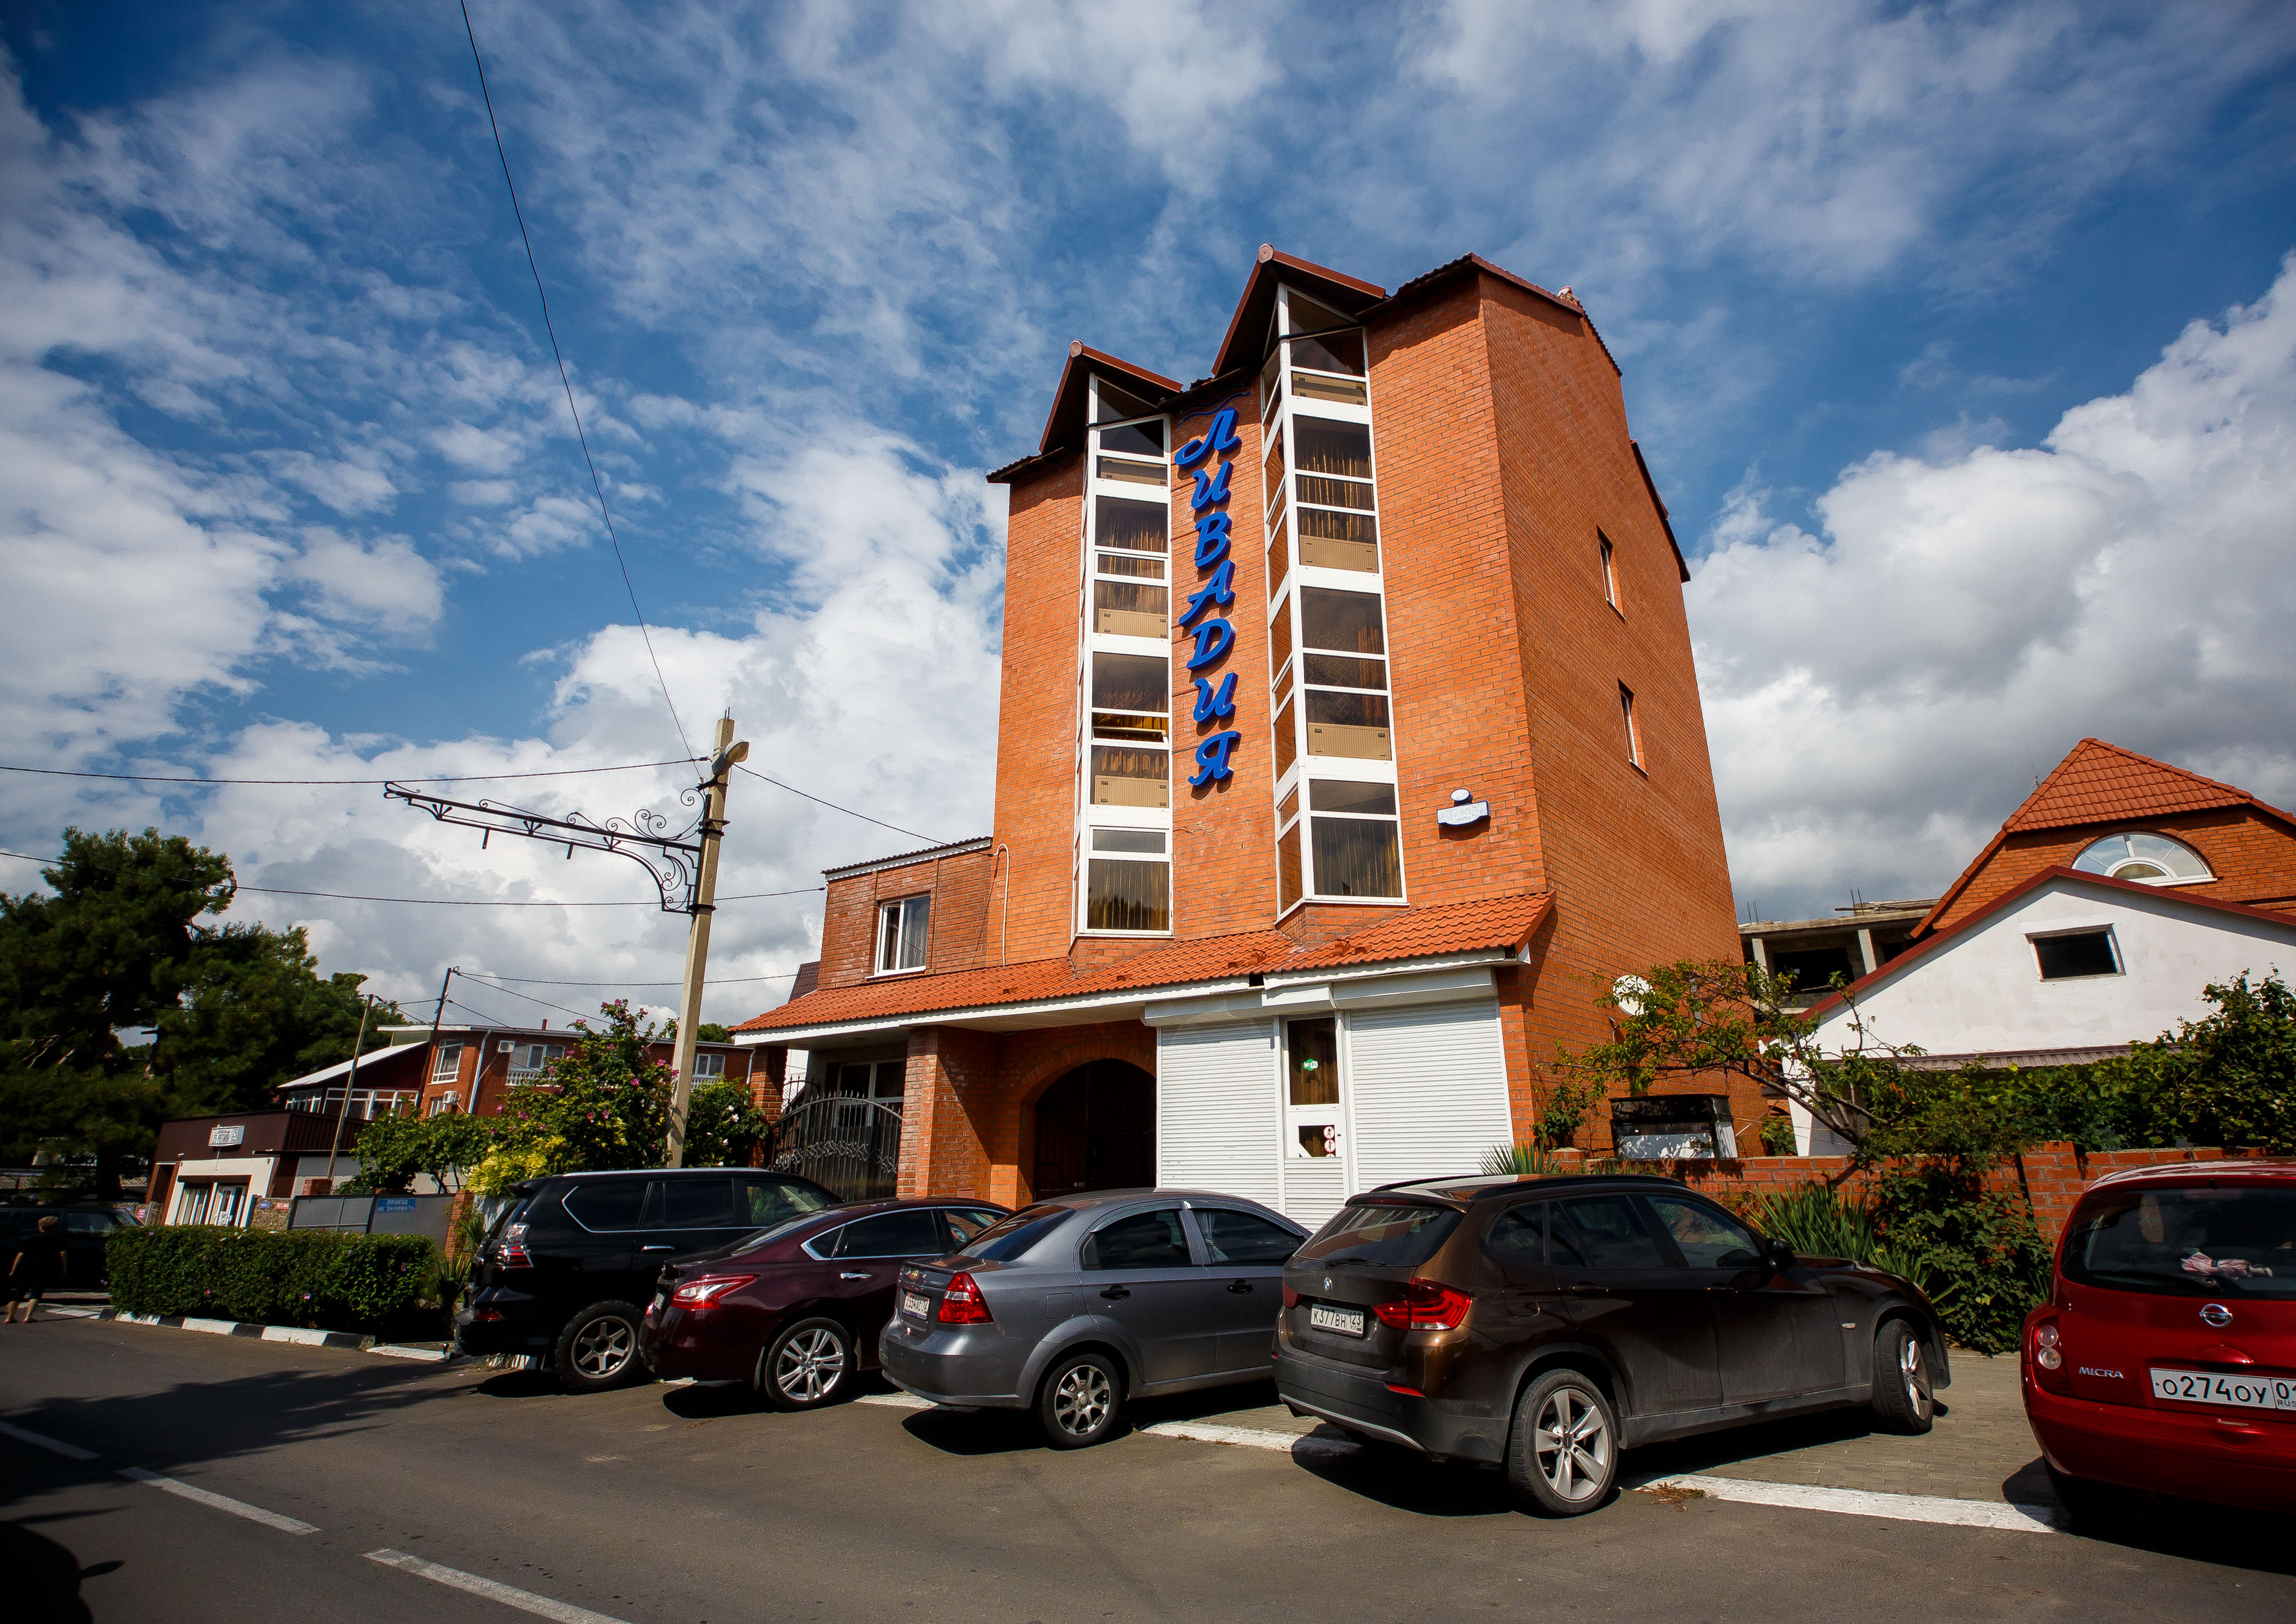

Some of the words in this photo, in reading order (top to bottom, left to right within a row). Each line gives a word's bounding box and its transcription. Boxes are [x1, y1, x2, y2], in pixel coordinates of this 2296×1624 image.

[1175, 407, 1242, 789] ЛИВАДИЯ
[1314, 1307, 1346, 1328] К377ВН
[1348, 1311, 1361, 1326] 123
[2079, 1367, 2124, 1379] MICRA
[2162, 1375, 2267, 1404] О274ОУ
[2275, 1382, 2296, 1400] 0
